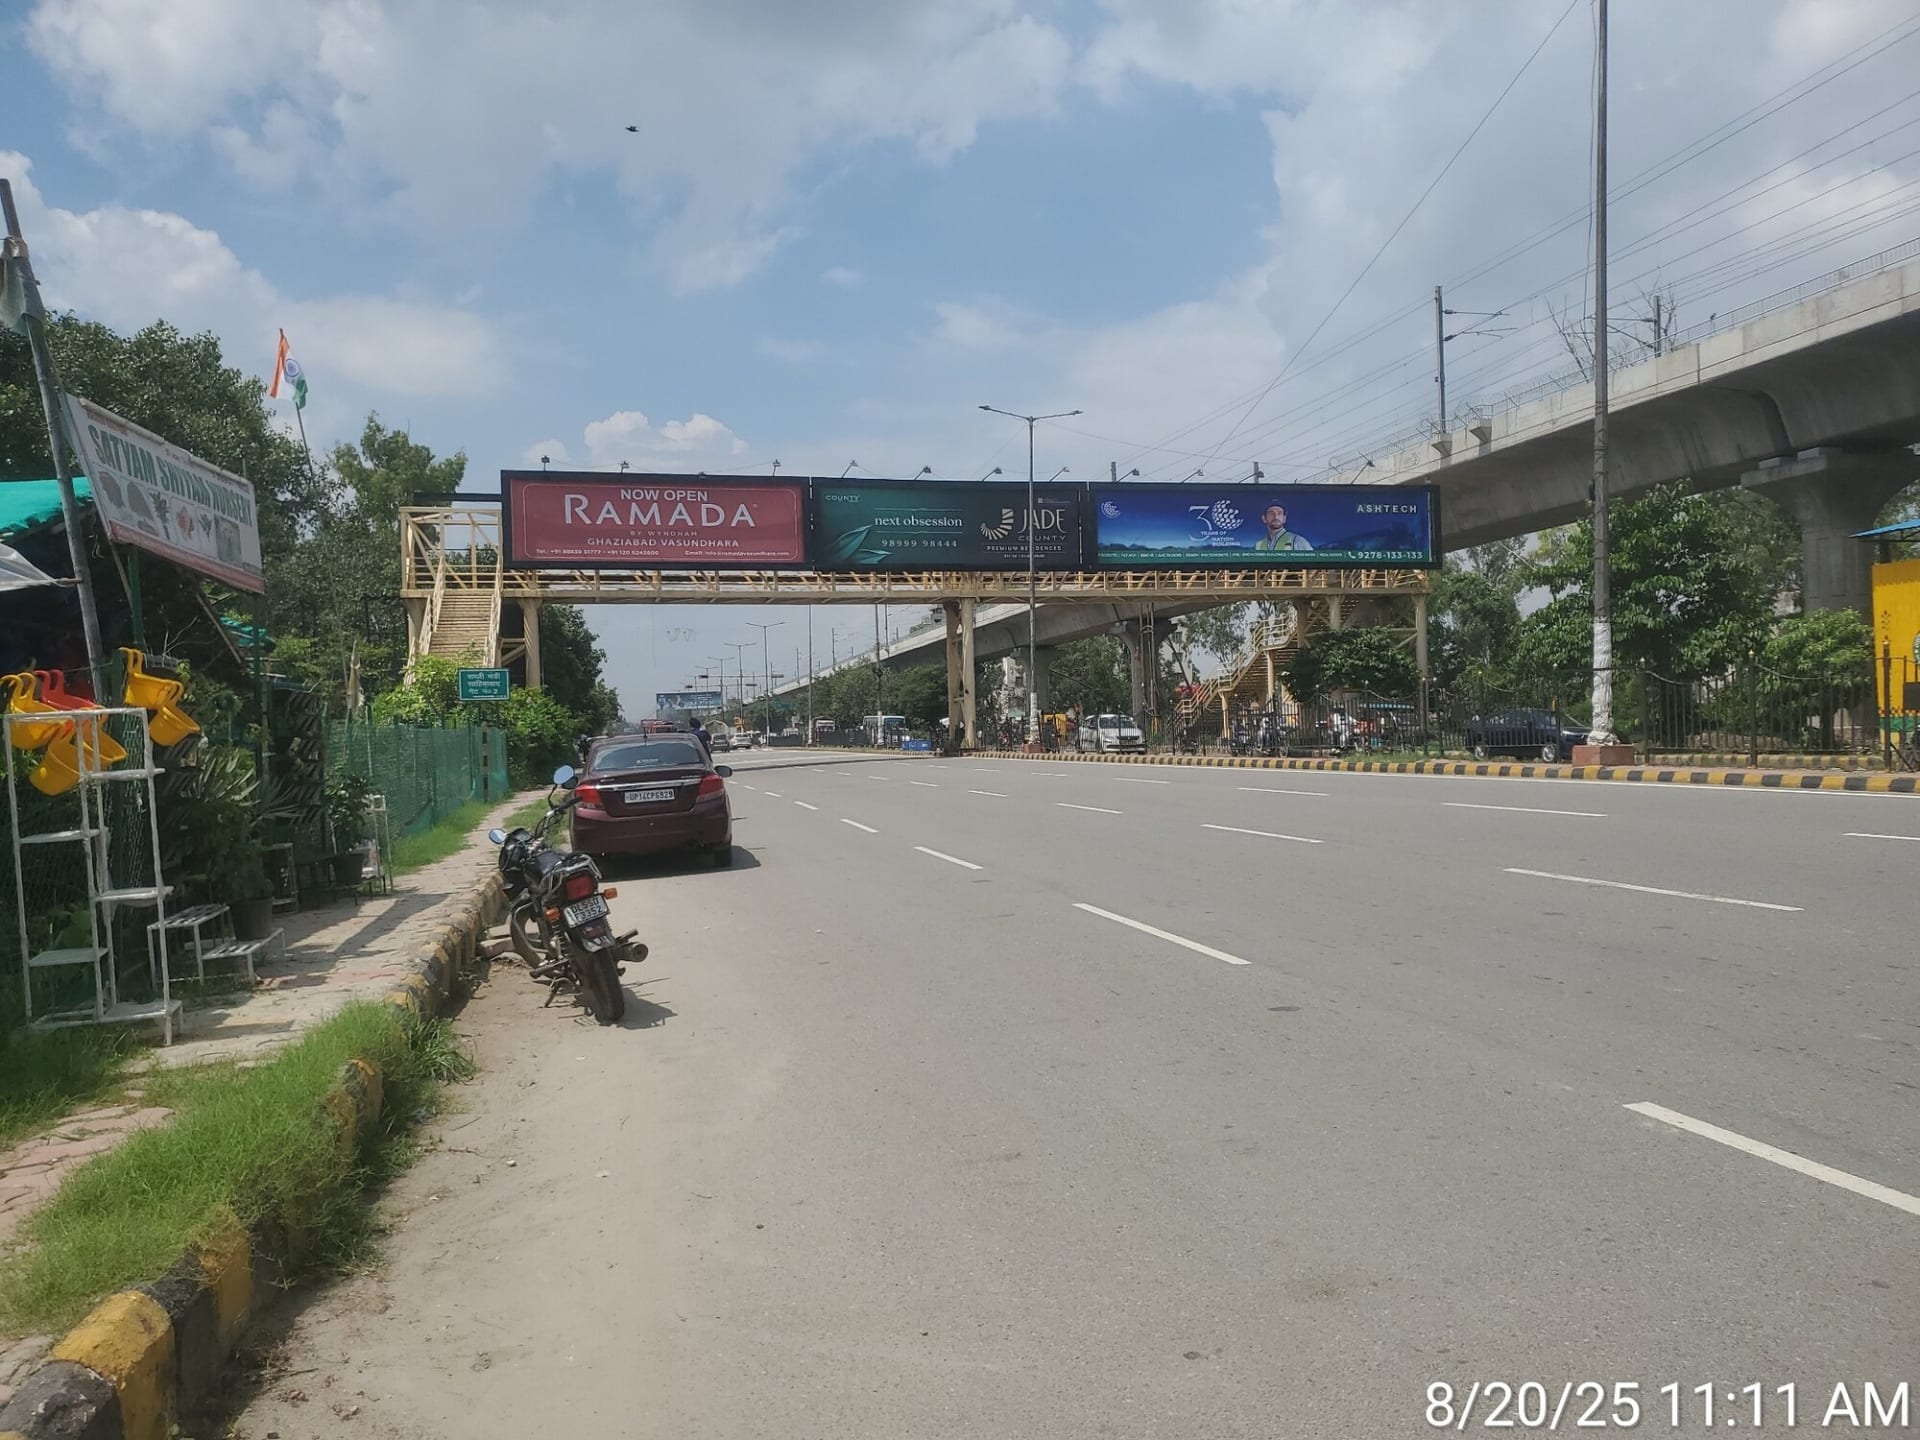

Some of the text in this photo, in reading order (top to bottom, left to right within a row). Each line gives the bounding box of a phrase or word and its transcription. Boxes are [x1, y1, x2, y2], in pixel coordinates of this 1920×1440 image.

[88, 424, 158, 486] SATYAM
[620, 489, 708, 501] NOW OPEN
[564, 493, 756, 528] RAMADA
[1356, 504, 1418, 513] ASHTECH
[875, 515, 963, 527] next obsession
[1016, 508, 1067, 534] JADE
[587, 537, 740, 548] GHAZIABAD VASUNDHARA
[881, 539, 957, 547] 98999 98444
[1357, 551, 1424, 560] 9278-133-133
